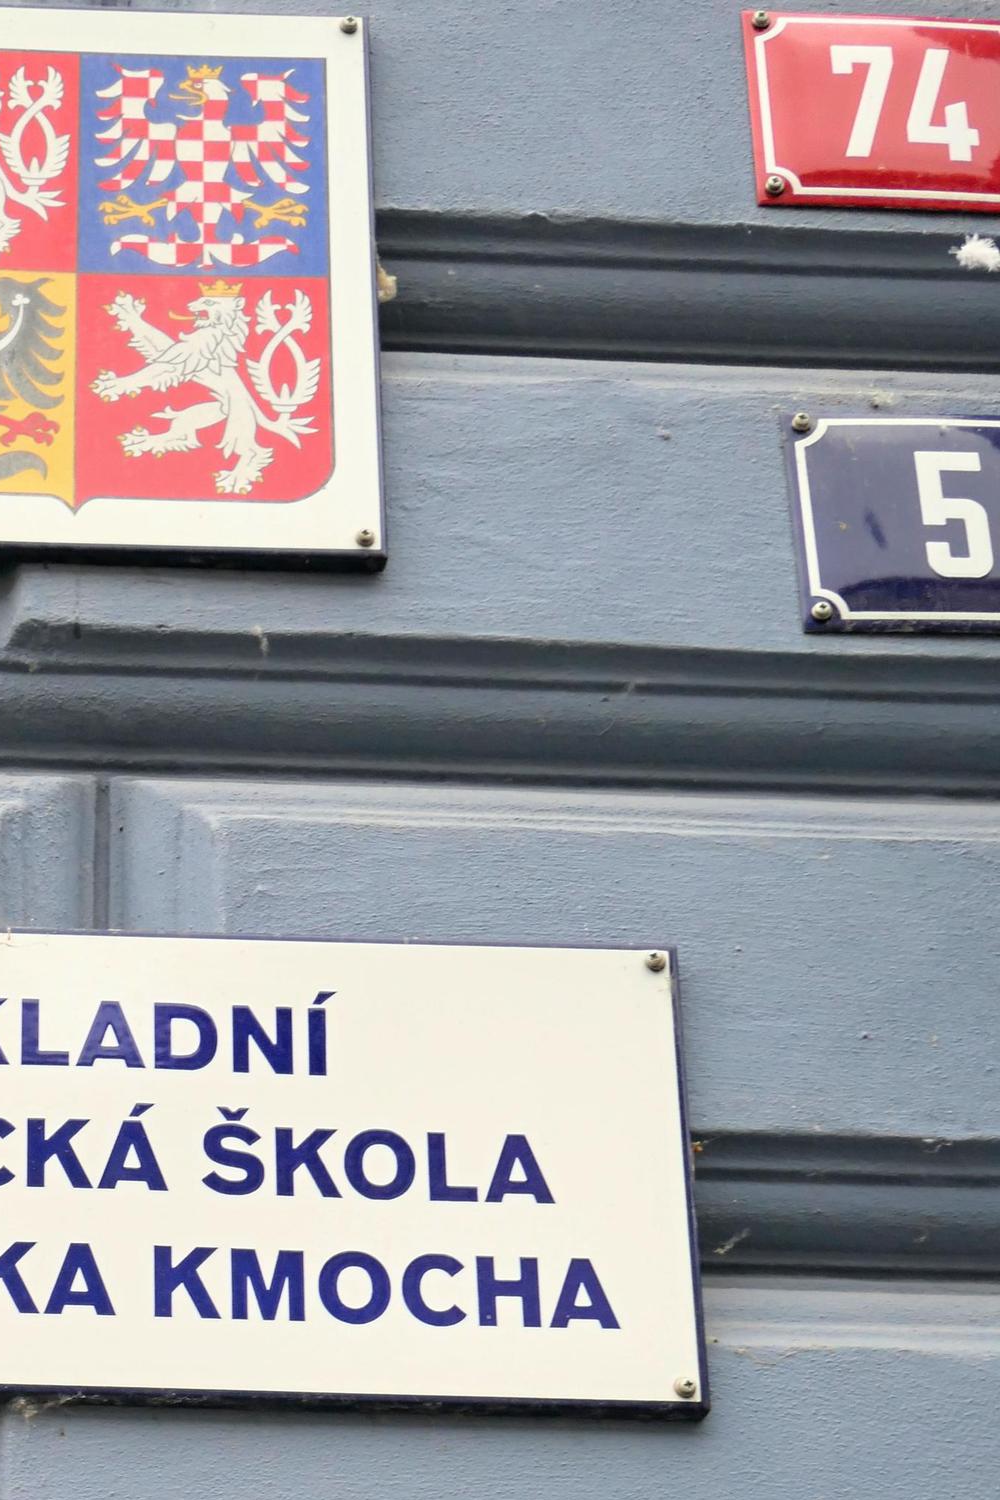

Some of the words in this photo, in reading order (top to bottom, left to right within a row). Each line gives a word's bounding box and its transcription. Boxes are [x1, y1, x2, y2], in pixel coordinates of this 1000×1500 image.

[829, 44, 980, 162] 74
[913, 450, 995, 578] 5
[201, 1107, 556, 1204] ŠKOLA
[153, 1244, 621, 1330] KMOCHA
